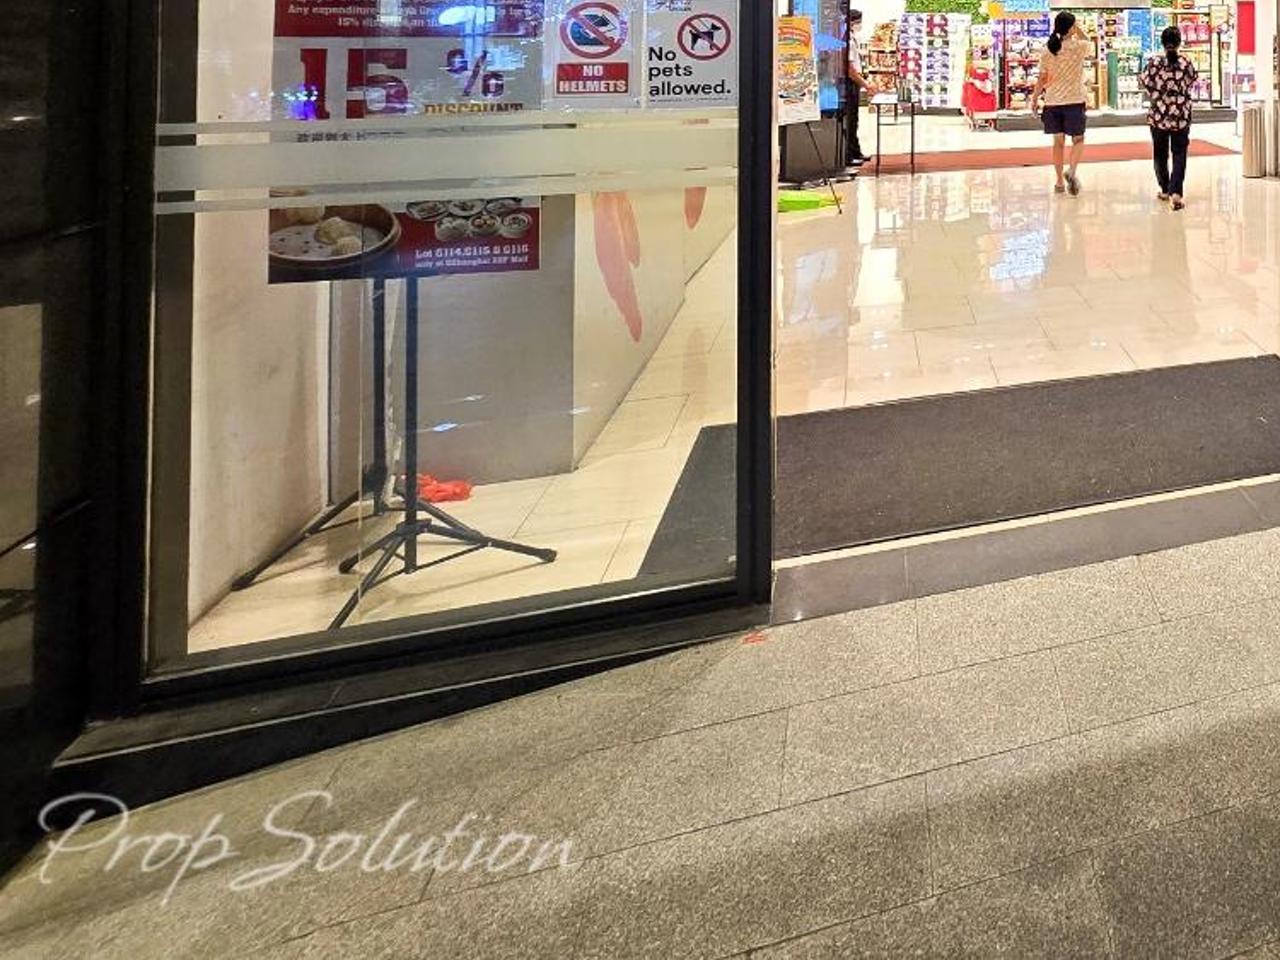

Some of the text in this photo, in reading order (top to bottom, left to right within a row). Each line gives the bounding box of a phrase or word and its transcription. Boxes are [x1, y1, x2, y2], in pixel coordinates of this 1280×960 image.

[649, 46, 677, 62] No
[583, 64, 604, 77] NO
[649, 63, 693, 81] pets
[300, 48, 409, 120] 15
[559, 79, 628, 93] HELMETS
[649, 79, 732, 96] allowed.
[415, 248, 432, 259] Lot
